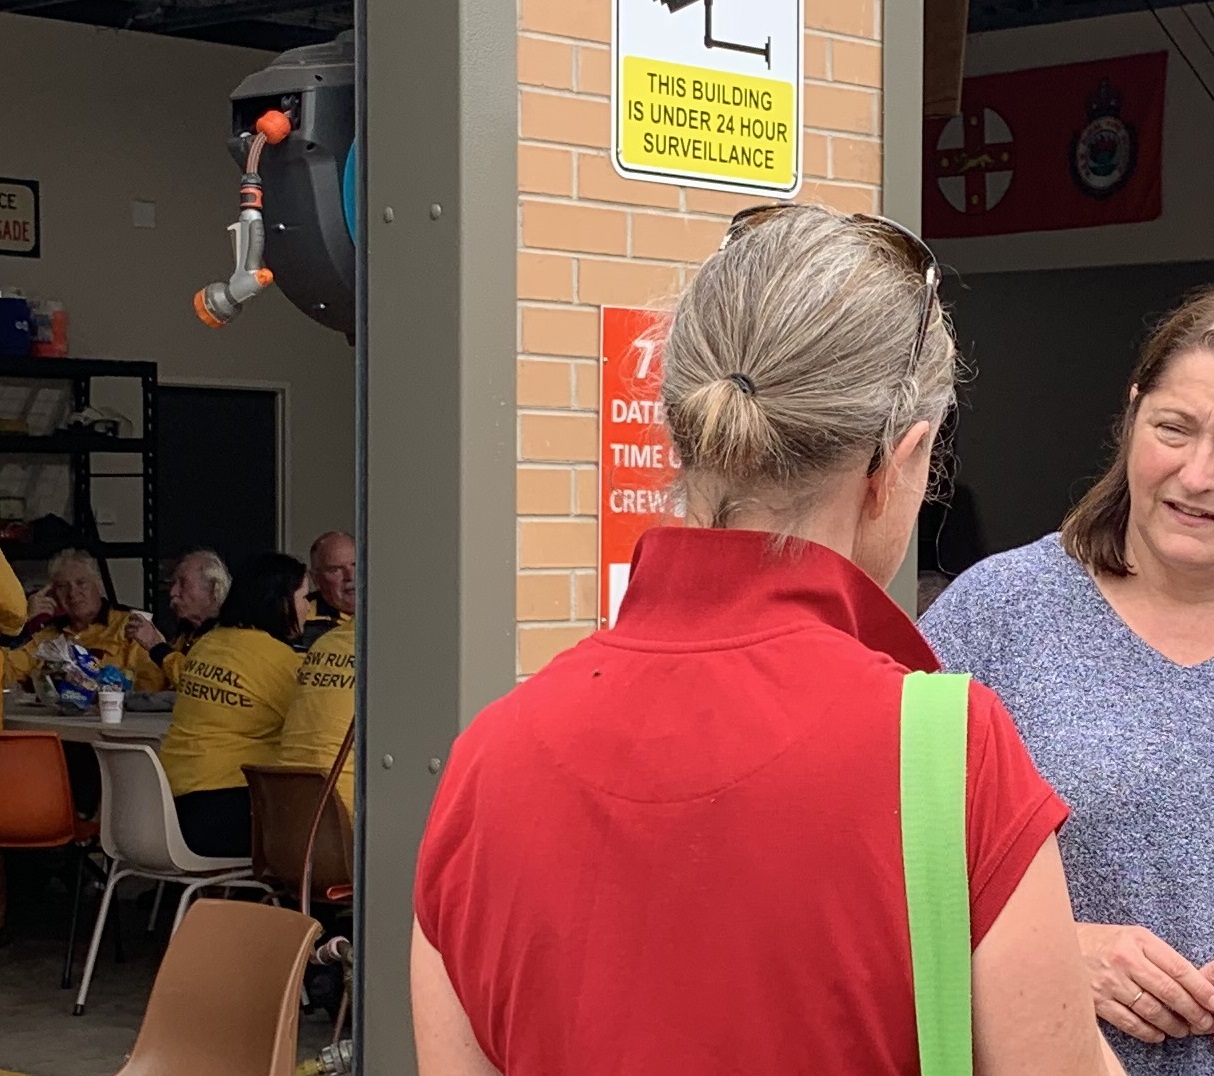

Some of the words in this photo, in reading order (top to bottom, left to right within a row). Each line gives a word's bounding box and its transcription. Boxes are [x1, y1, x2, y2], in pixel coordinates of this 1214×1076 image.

[647, 72, 687, 98] THIS
[692, 80, 773, 111] BUILDING
[628, 100, 644, 121] IS
[650, 103, 711, 132] UNDER
[716, 114, 736, 135] 24
[740, 118, 788, 143] HOUR
[643, 133, 775, 169] SURVEILLANCE
[633, 339, 657, 379] 7
[610, 443, 663, 468] TIME
[610, 489, 669, 514] CREW
[195, 662, 244, 689] RURAL
[311, 673, 355, 689] SERVI
[184, 681, 254, 708] SERVICE
